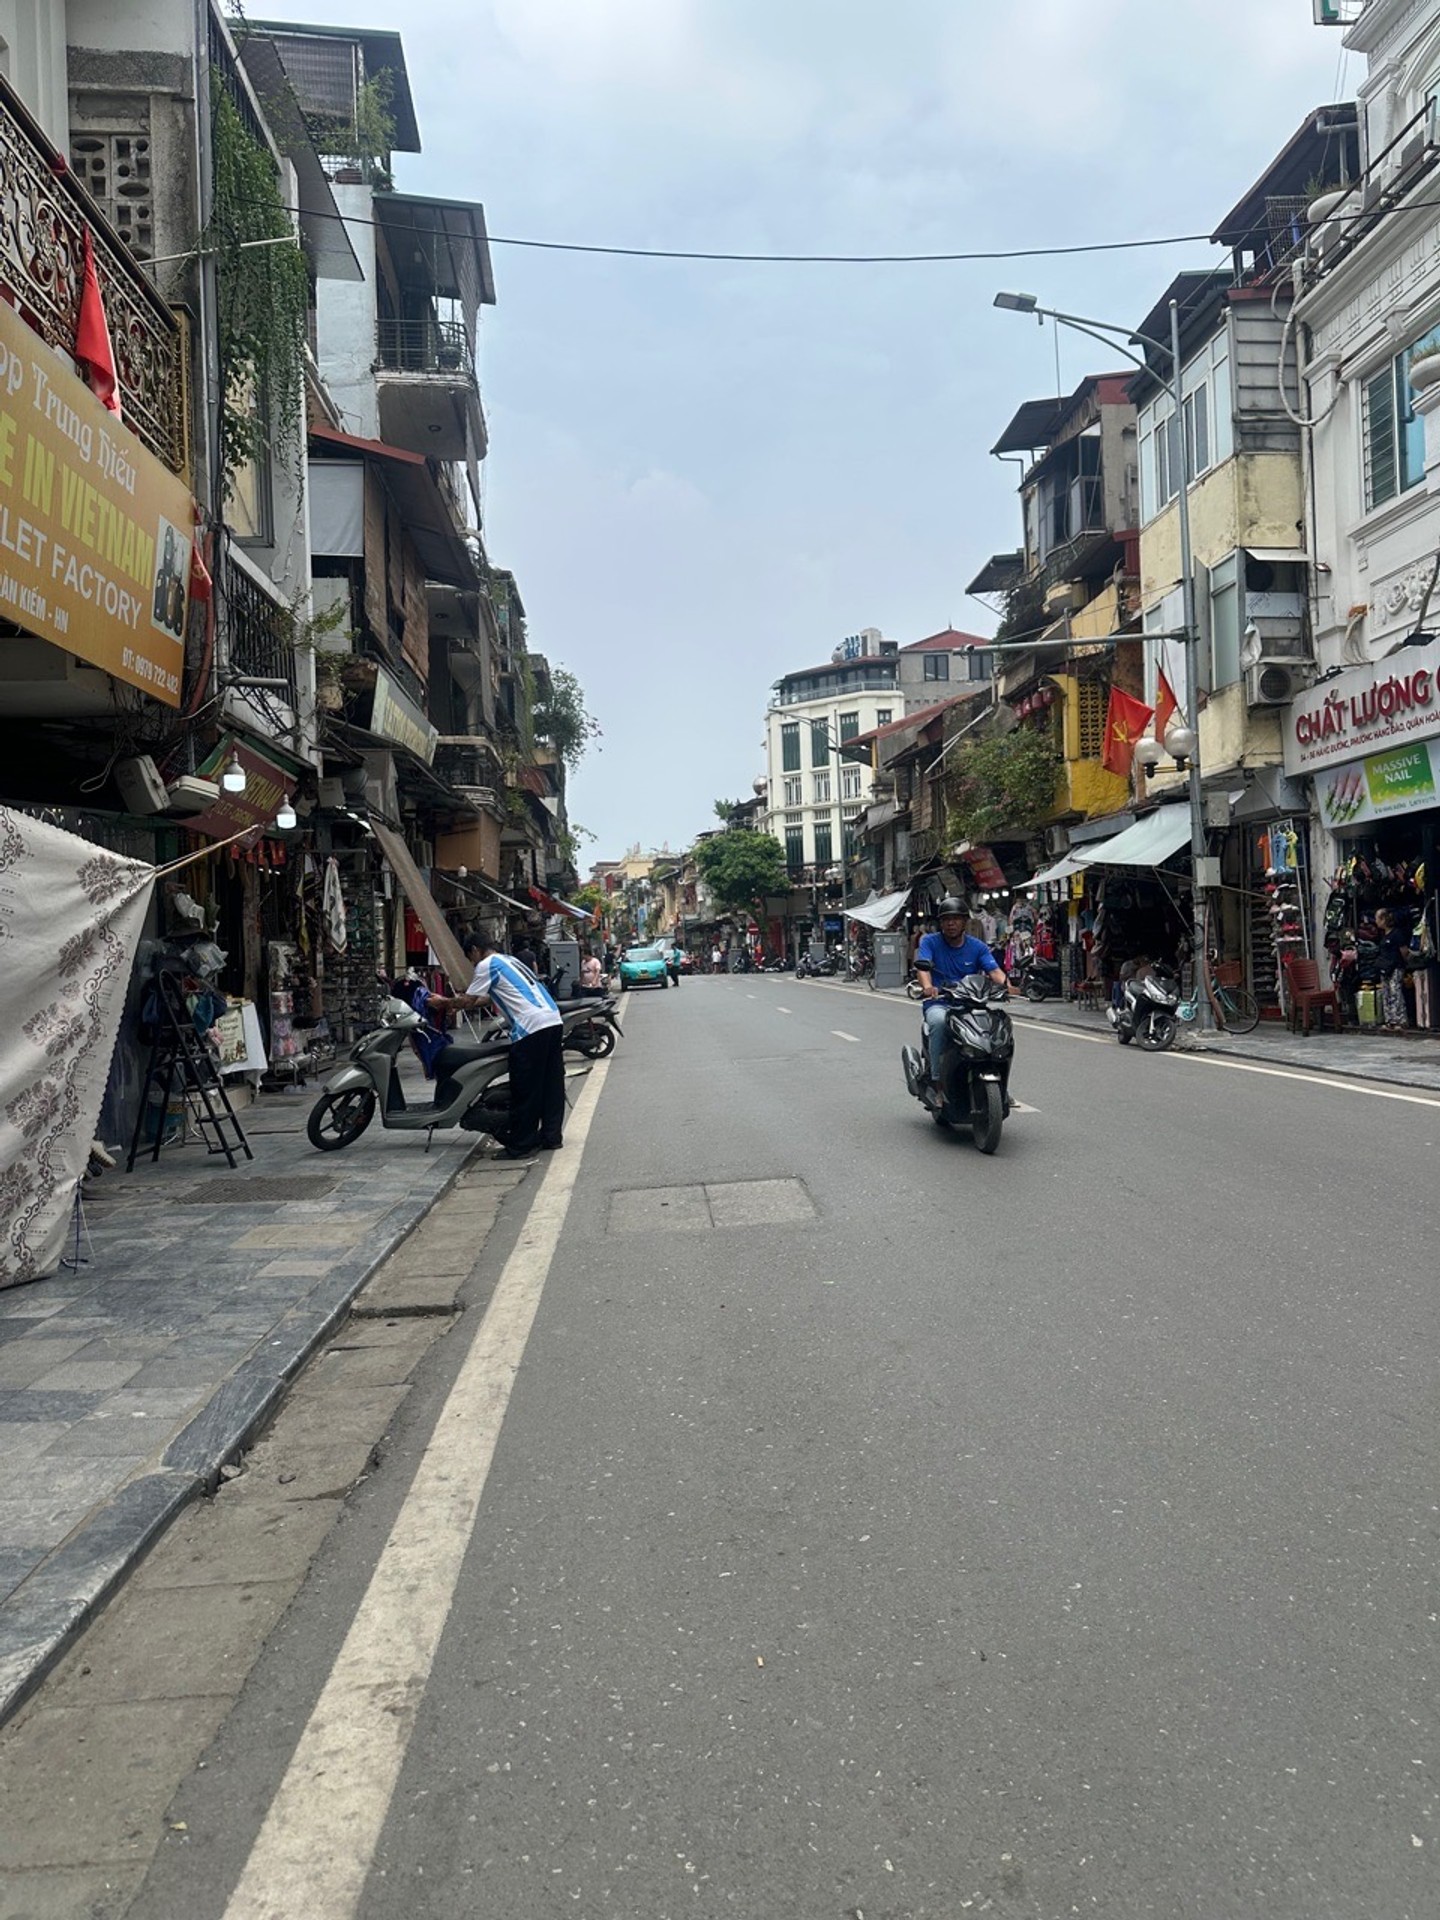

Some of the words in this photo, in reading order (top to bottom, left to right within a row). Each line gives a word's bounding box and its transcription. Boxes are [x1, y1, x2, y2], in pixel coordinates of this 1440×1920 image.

[32, 362, 93, 463] Trung
[22, 433, 56, 517] IN
[61, 462, 154, 591] VIETNAM
[0, 503, 48, 568] LET
[52, 542, 143, 630] FACTORY
[1296, 689, 1346, 745] CHẤT
[1350, 670, 1431, 726] LƯỢNG
[1372, 753, 1422, 776] MASSIVE
[1384, 769, 1413, 784] NAIL
